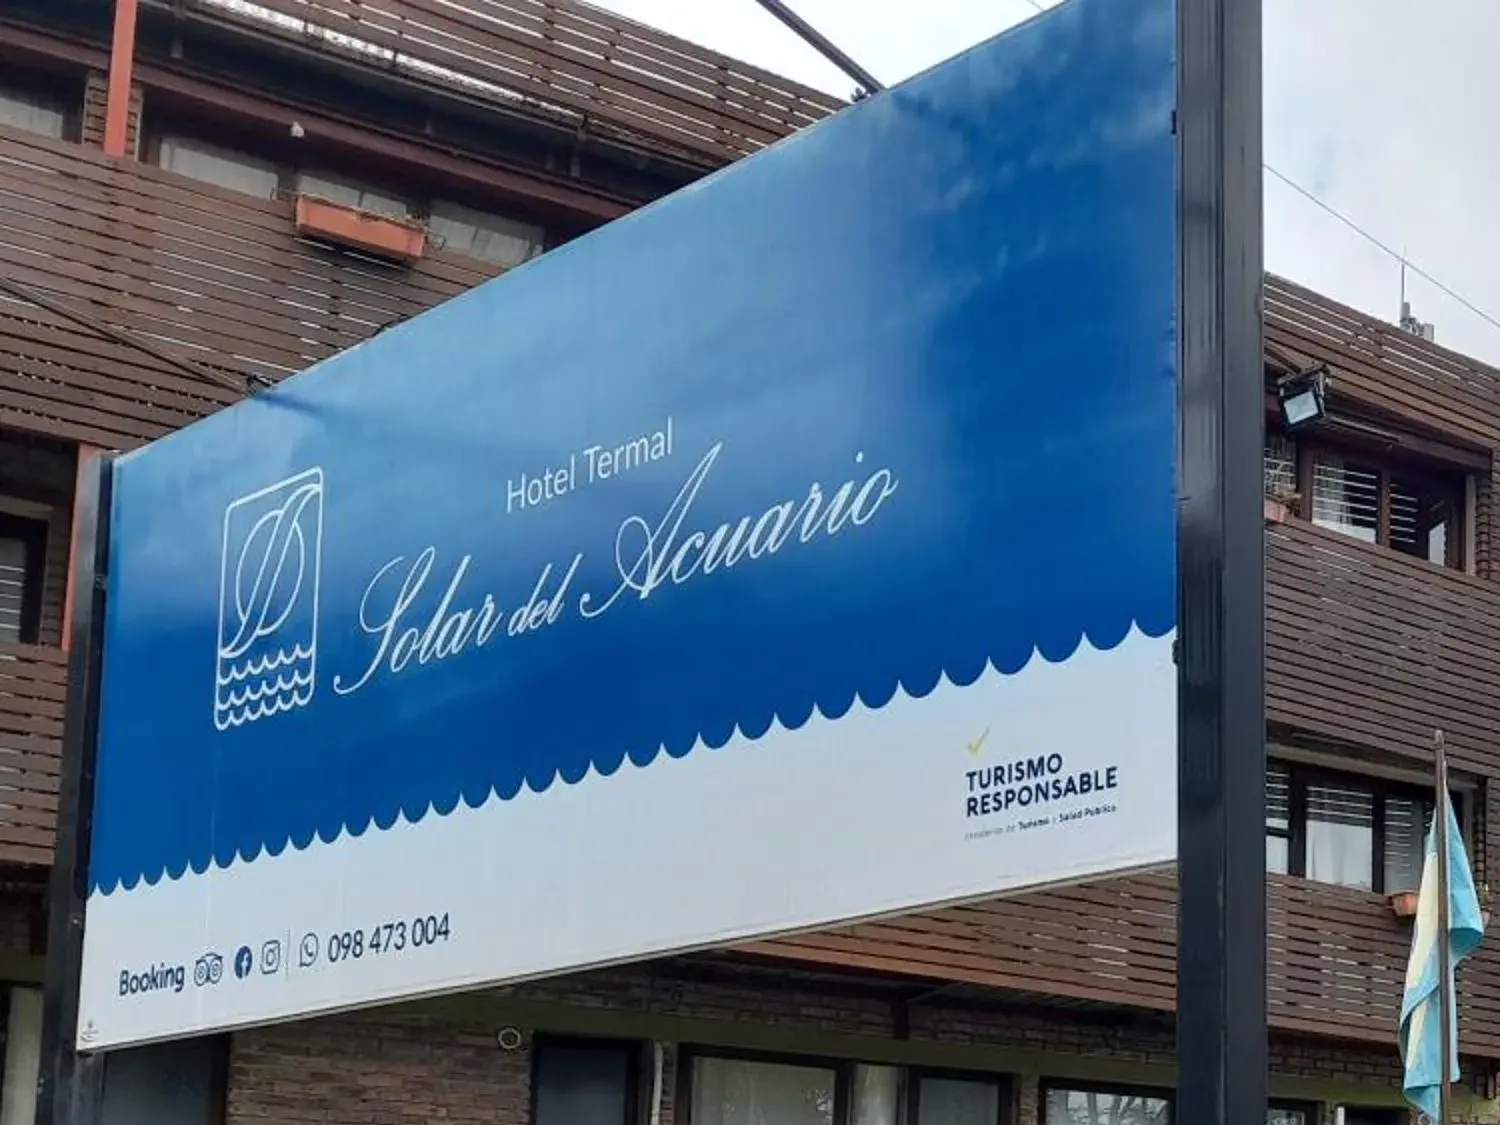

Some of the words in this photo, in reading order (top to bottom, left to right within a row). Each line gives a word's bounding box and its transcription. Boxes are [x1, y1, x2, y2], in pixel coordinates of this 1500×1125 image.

[507, 454, 576, 513] Hotel
[583, 416, 674, 483] Termal
[333, 546, 501, 695] Solar
[507, 553, 583, 637] del
[580, 441, 899, 618] Acuario
[965, 752, 1063, 792] TURISMO
[966, 765, 1119, 818] RESPONSABLE
[119, 962, 186, 996] Booking
[327, 929, 364, 963] 098
[368, 919, 407, 954] 473
[411, 911, 451, 948] 004
